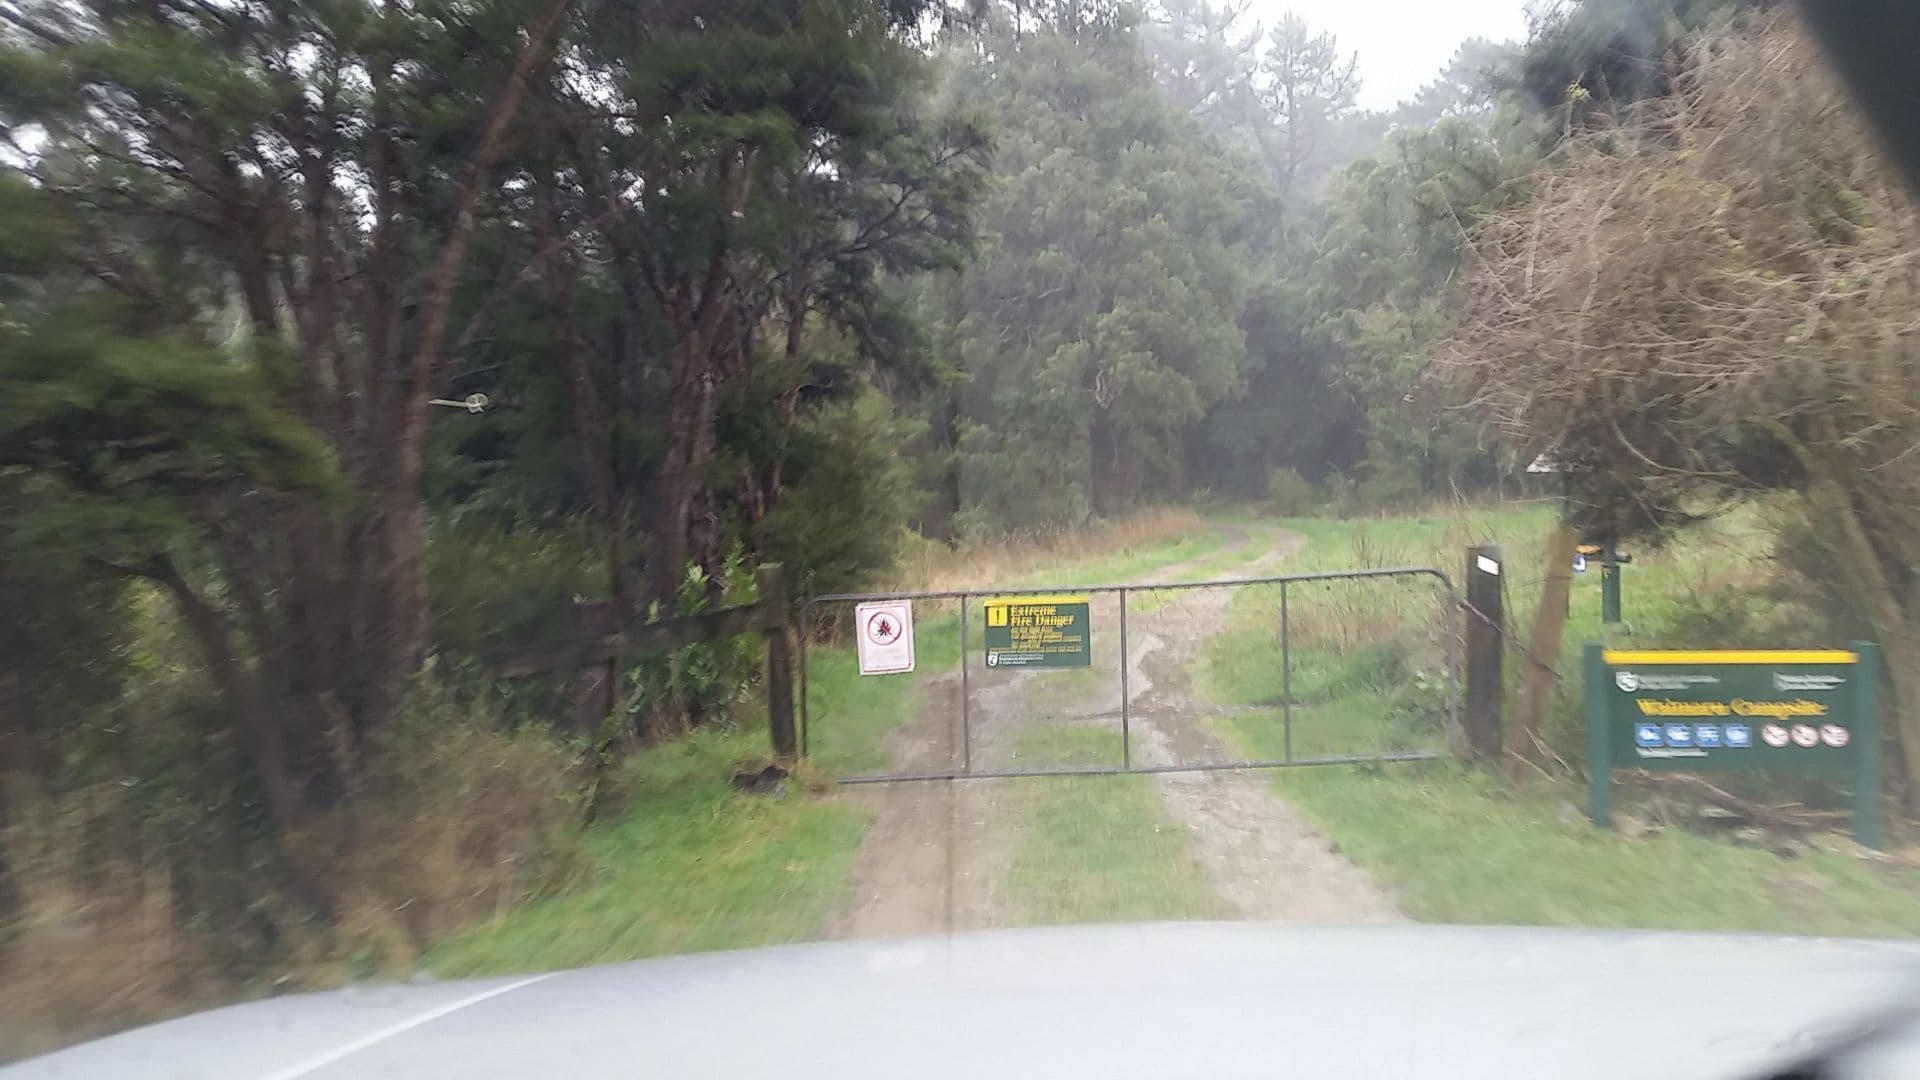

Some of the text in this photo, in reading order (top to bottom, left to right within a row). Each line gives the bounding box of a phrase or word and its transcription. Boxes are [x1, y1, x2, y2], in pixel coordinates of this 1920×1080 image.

[1010, 605, 1057, 616] Extreme
[1010, 614, 1075, 628] Fire Danger
